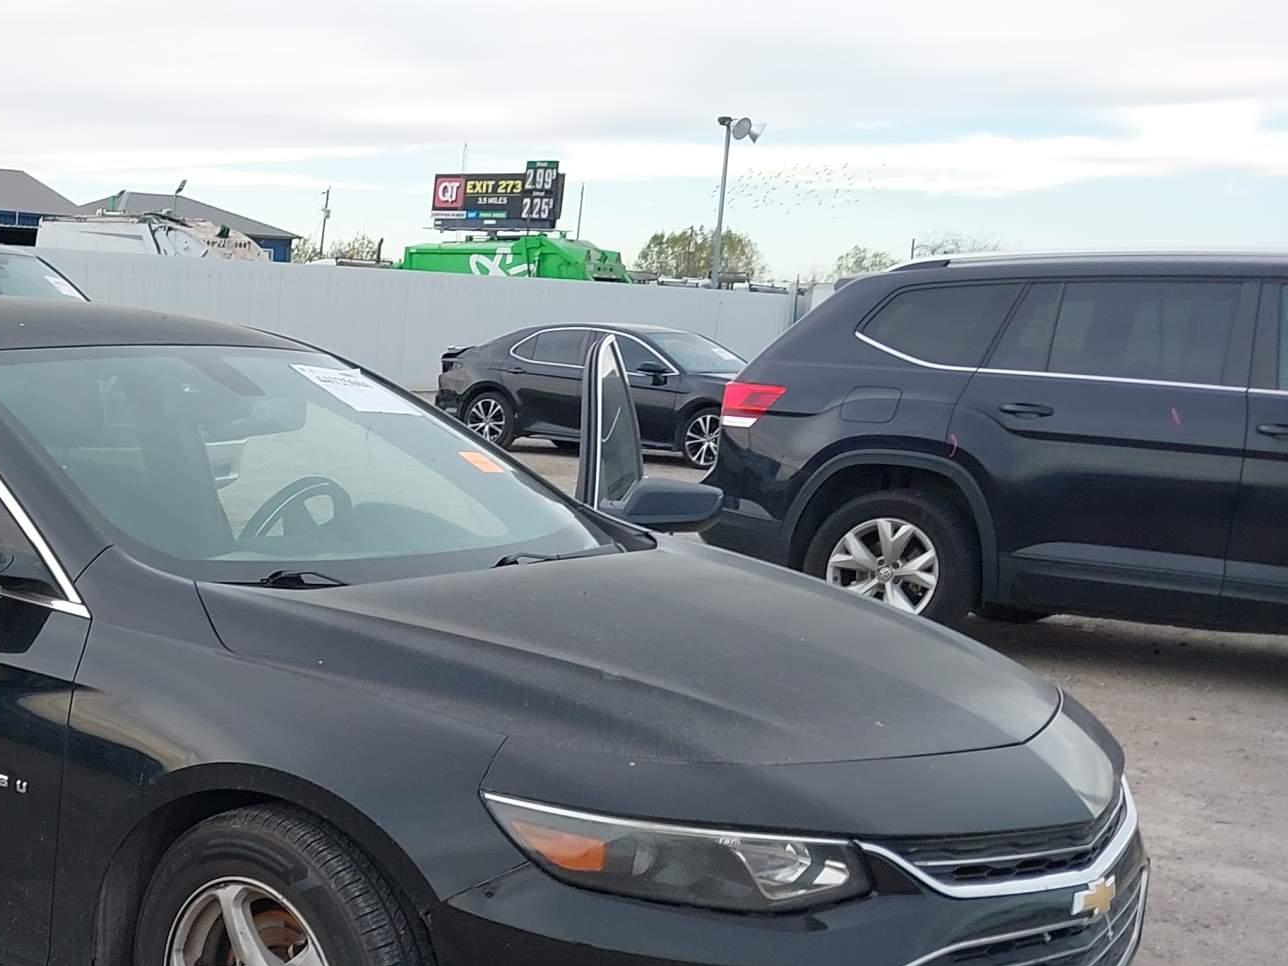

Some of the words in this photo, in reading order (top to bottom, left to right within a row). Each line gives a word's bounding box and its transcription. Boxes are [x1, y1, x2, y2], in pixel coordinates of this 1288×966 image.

[438, 182, 460, 203] QT
[466, 180, 495, 193] EXIT
[497, 180, 523, 193] 273
